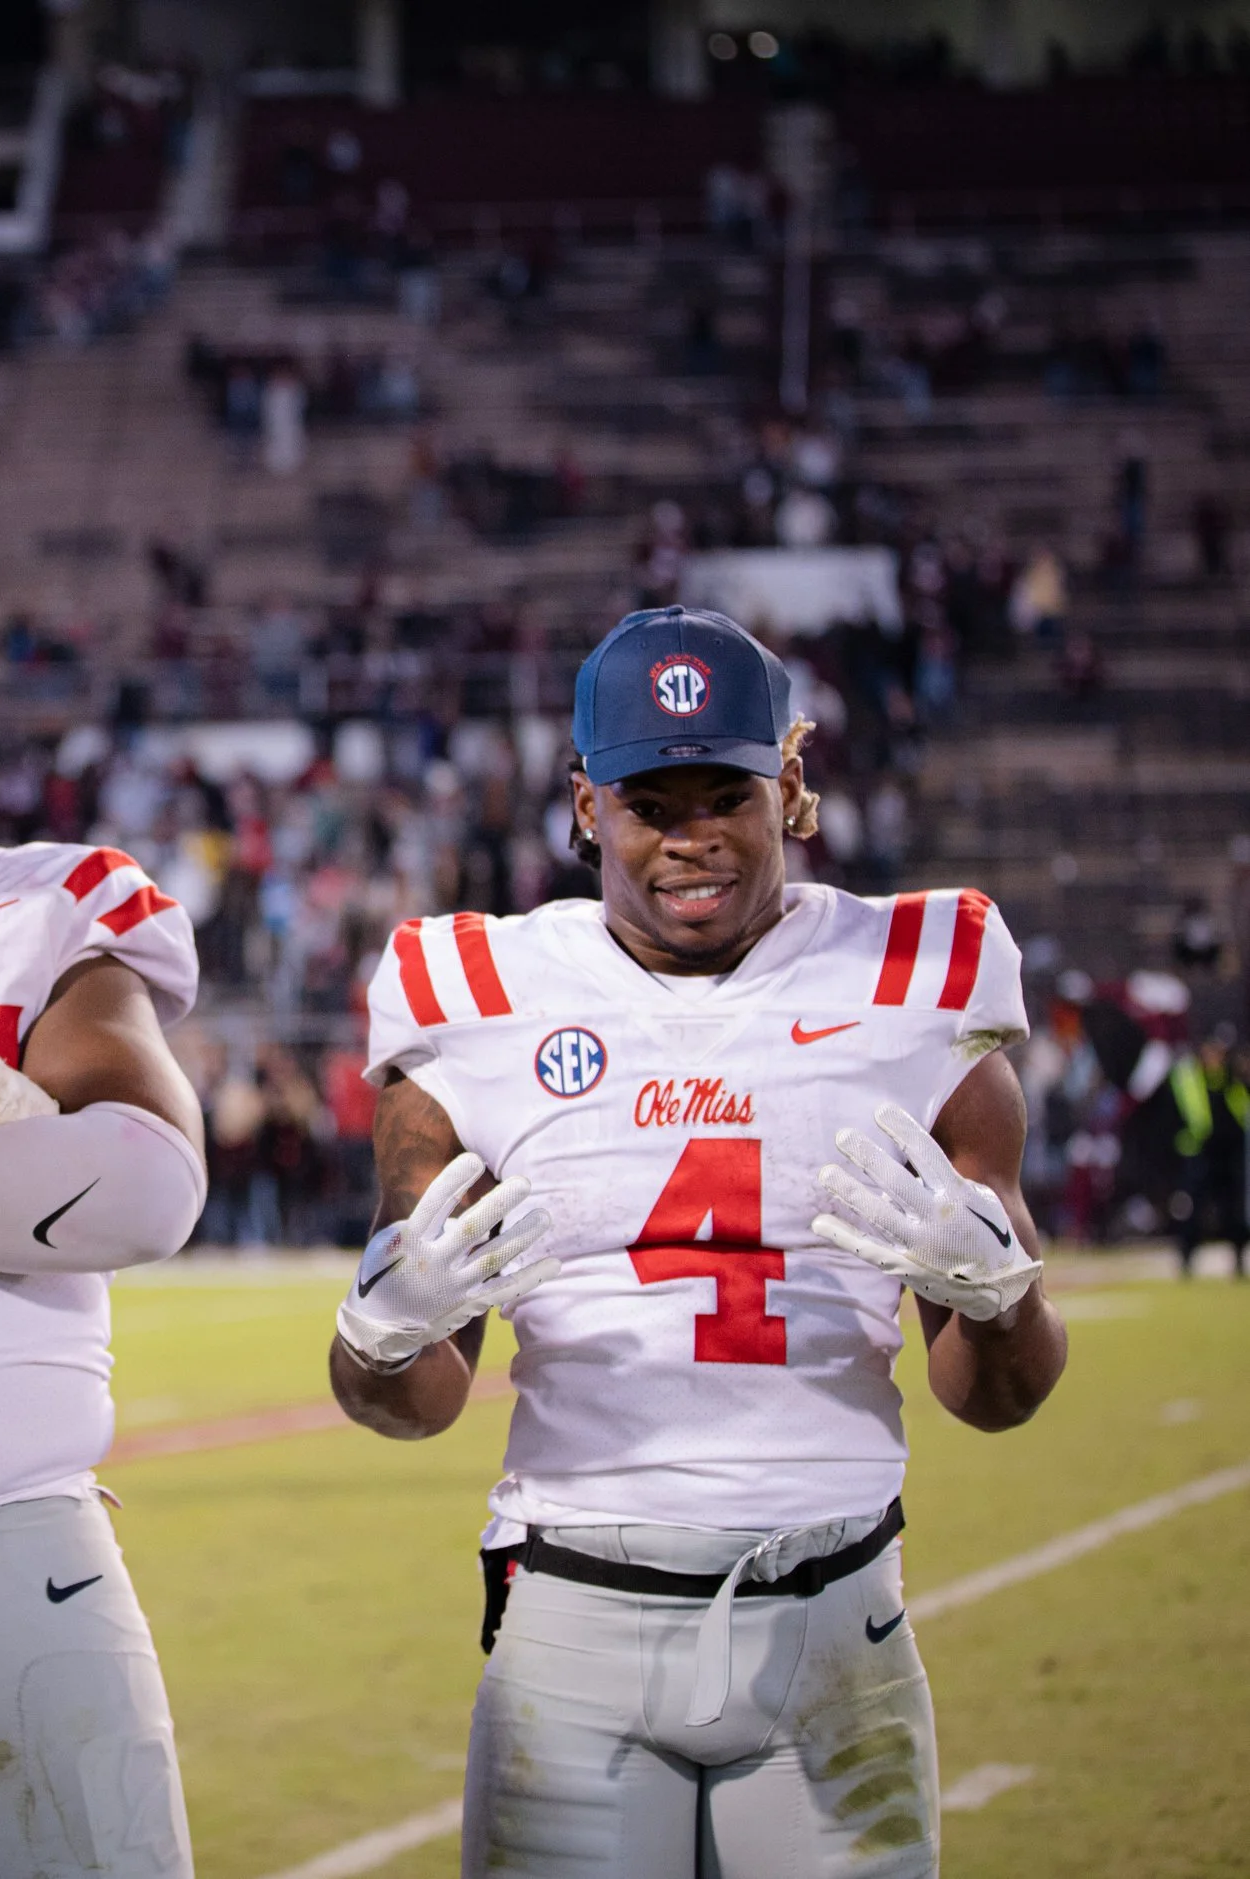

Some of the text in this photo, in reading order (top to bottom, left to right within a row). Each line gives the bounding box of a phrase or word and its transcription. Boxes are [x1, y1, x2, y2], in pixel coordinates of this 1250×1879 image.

[657, 664, 706, 713] SIP
[539, 1029, 601, 1095] SEC
[634, 1077, 756, 1128] Ole Miss
[626, 1138, 787, 1365] 4
